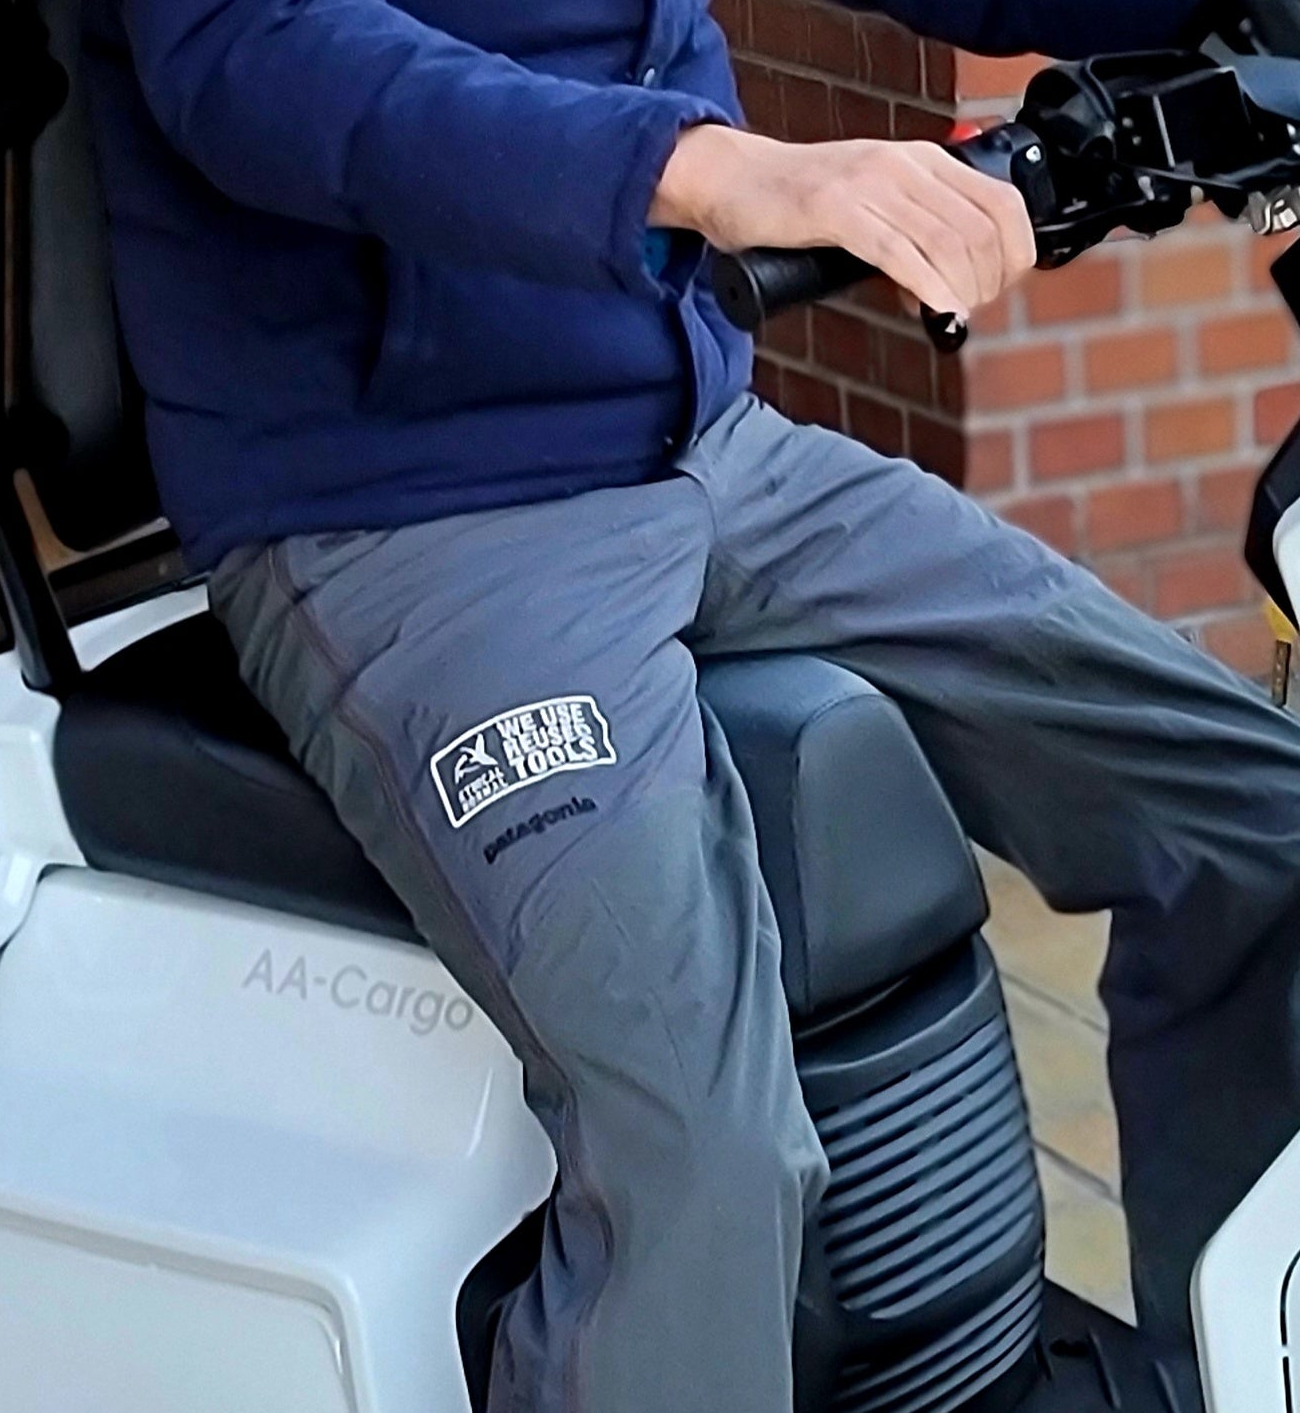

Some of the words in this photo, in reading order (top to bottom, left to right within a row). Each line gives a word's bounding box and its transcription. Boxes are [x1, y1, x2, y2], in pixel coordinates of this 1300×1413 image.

[496, 712, 537, 737] WE
[538, 703, 586, 725] USE
[509, 736, 599, 779] TOOLS
[483, 795, 597, 865] patagonia
[241, 948, 475, 1036] AA-Cargo
